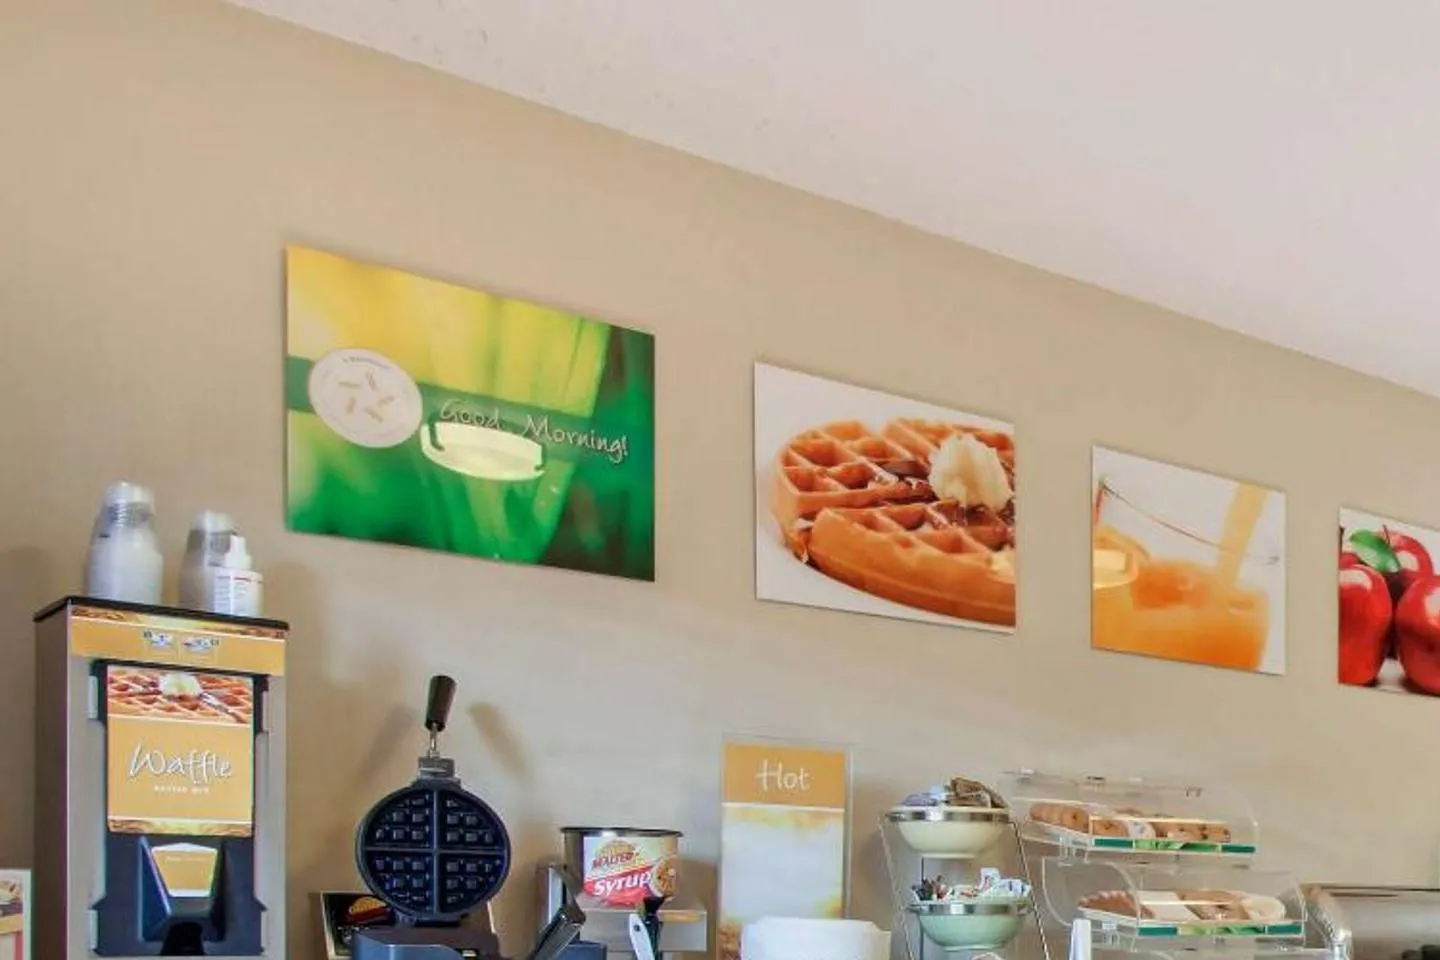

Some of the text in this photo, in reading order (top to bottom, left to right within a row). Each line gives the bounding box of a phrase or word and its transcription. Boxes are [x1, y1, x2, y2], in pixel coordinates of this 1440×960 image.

[440, 400, 629, 464] Good Morning!
[128, 742, 232, 784] Waffle
[755, 758, 813, 792] Hot
[594, 871, 651, 896] Syrup
